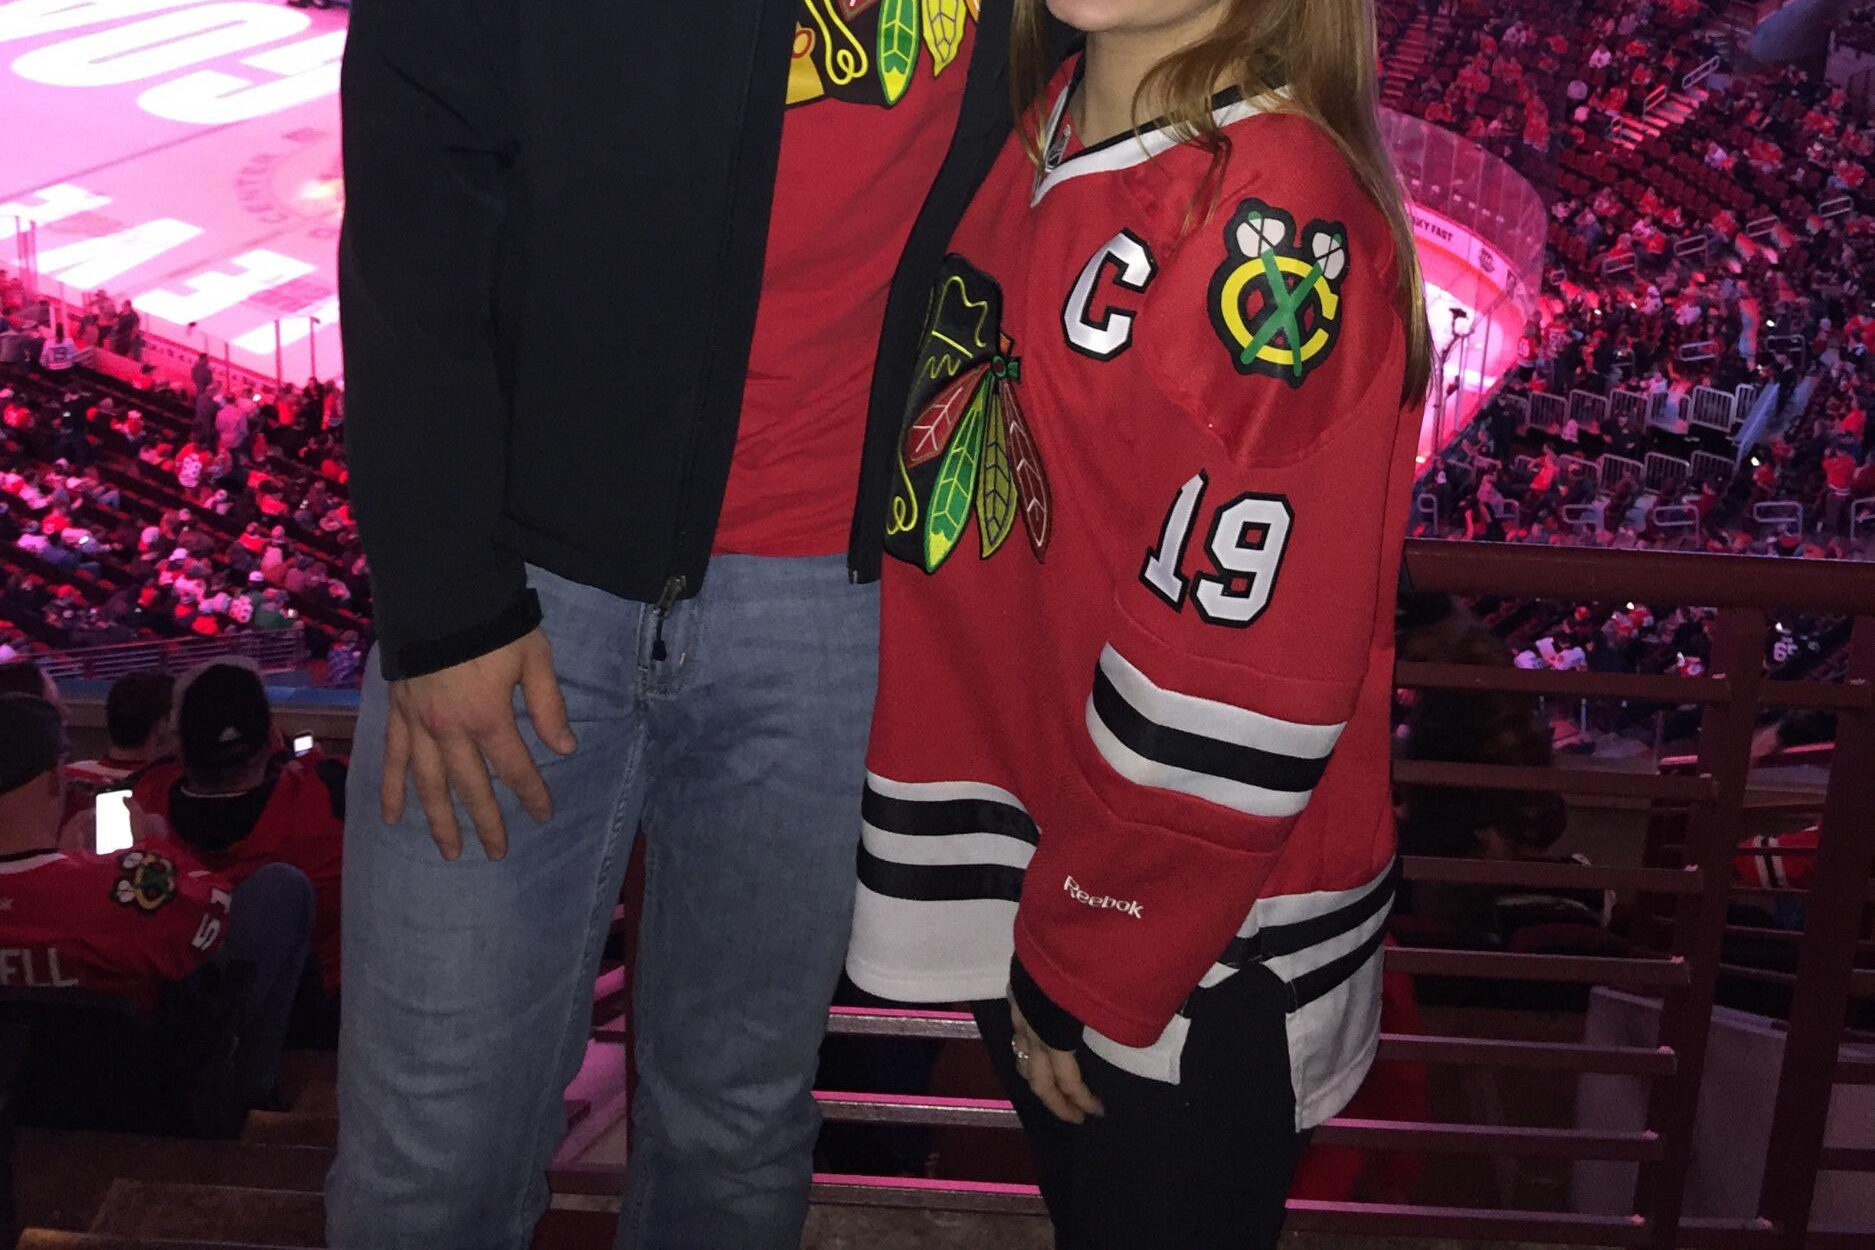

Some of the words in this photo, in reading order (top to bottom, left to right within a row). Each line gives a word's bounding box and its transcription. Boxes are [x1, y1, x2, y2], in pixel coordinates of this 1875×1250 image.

[1431, 225, 1454, 242] FAST
[1061, 228, 1158, 362] C
[1139, 469, 1295, 629] 19
[1063, 875, 1144, 919] Reebok
